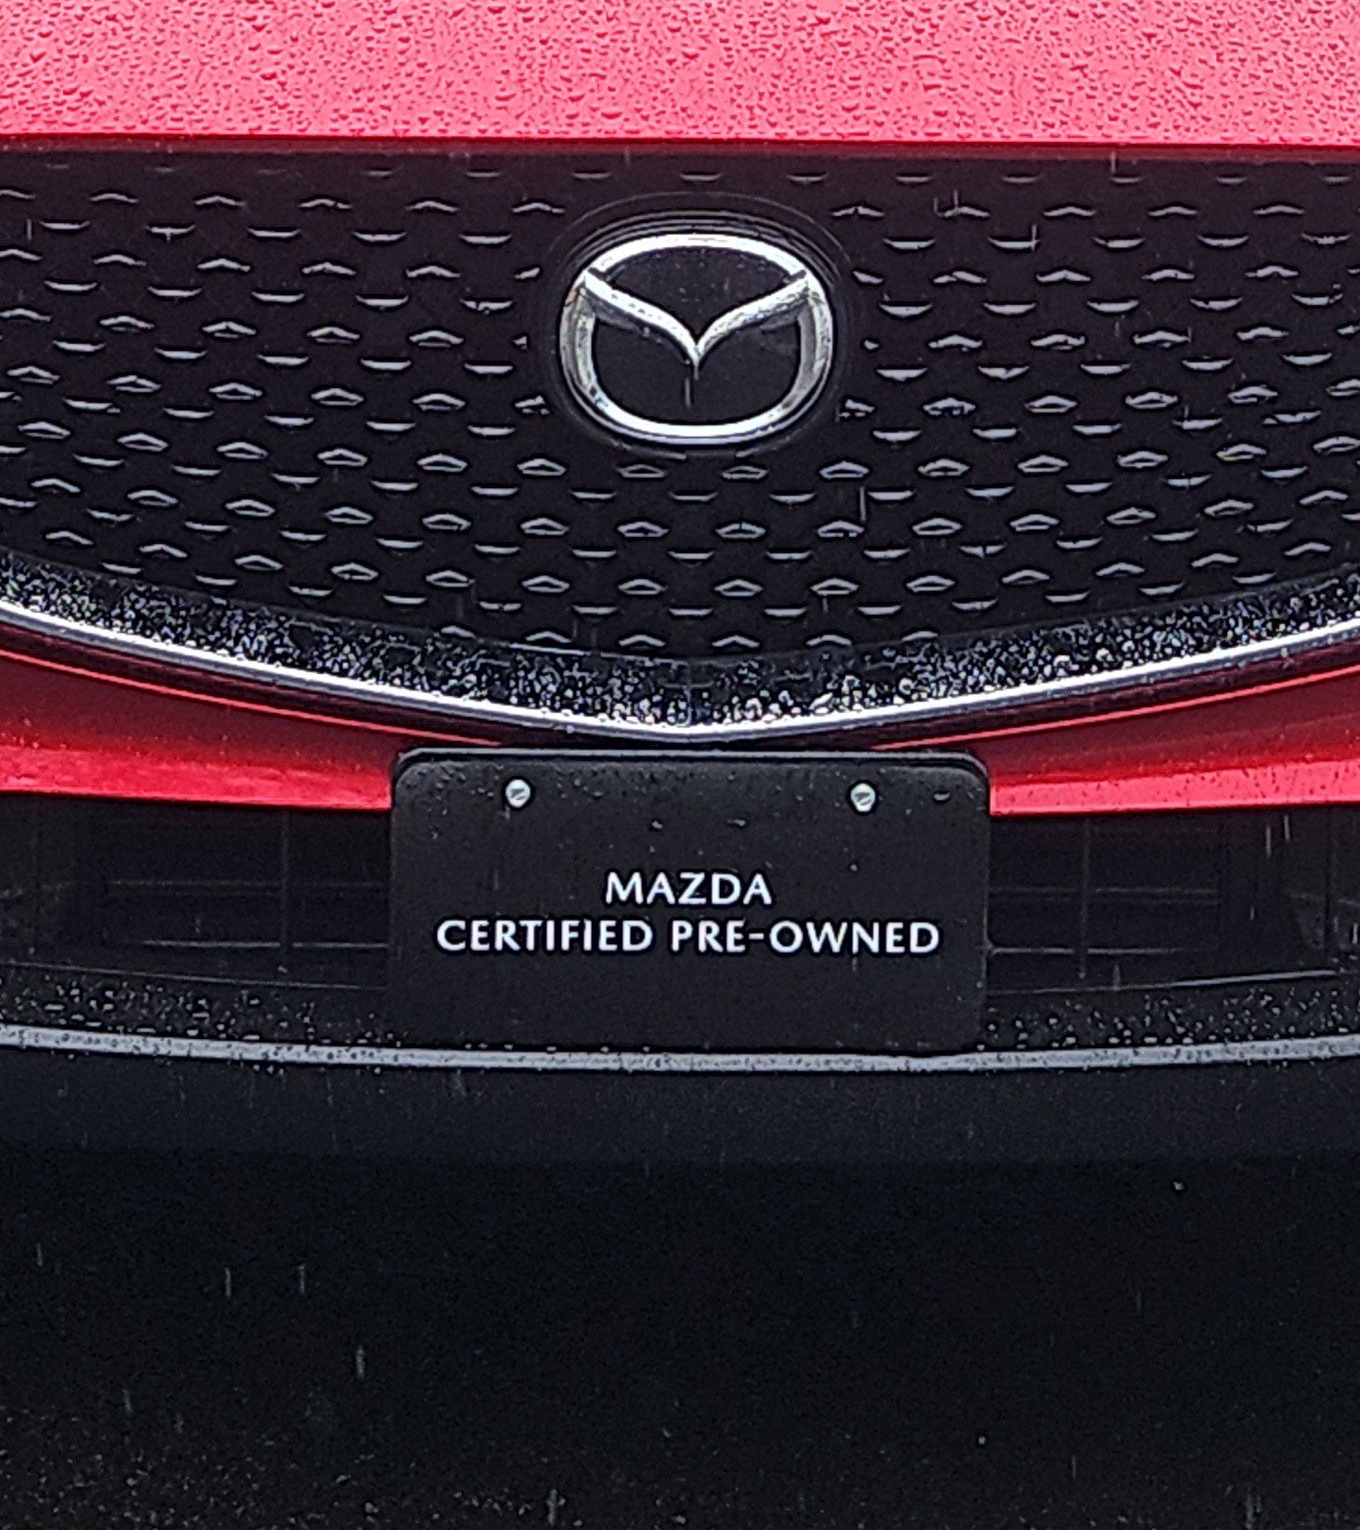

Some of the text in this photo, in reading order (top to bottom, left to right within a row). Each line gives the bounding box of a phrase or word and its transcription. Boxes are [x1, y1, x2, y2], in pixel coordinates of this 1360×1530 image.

[604, 870, 773, 906] MAZDA
[435, 918, 941, 954] CERTIFIED PRE-OWNED
